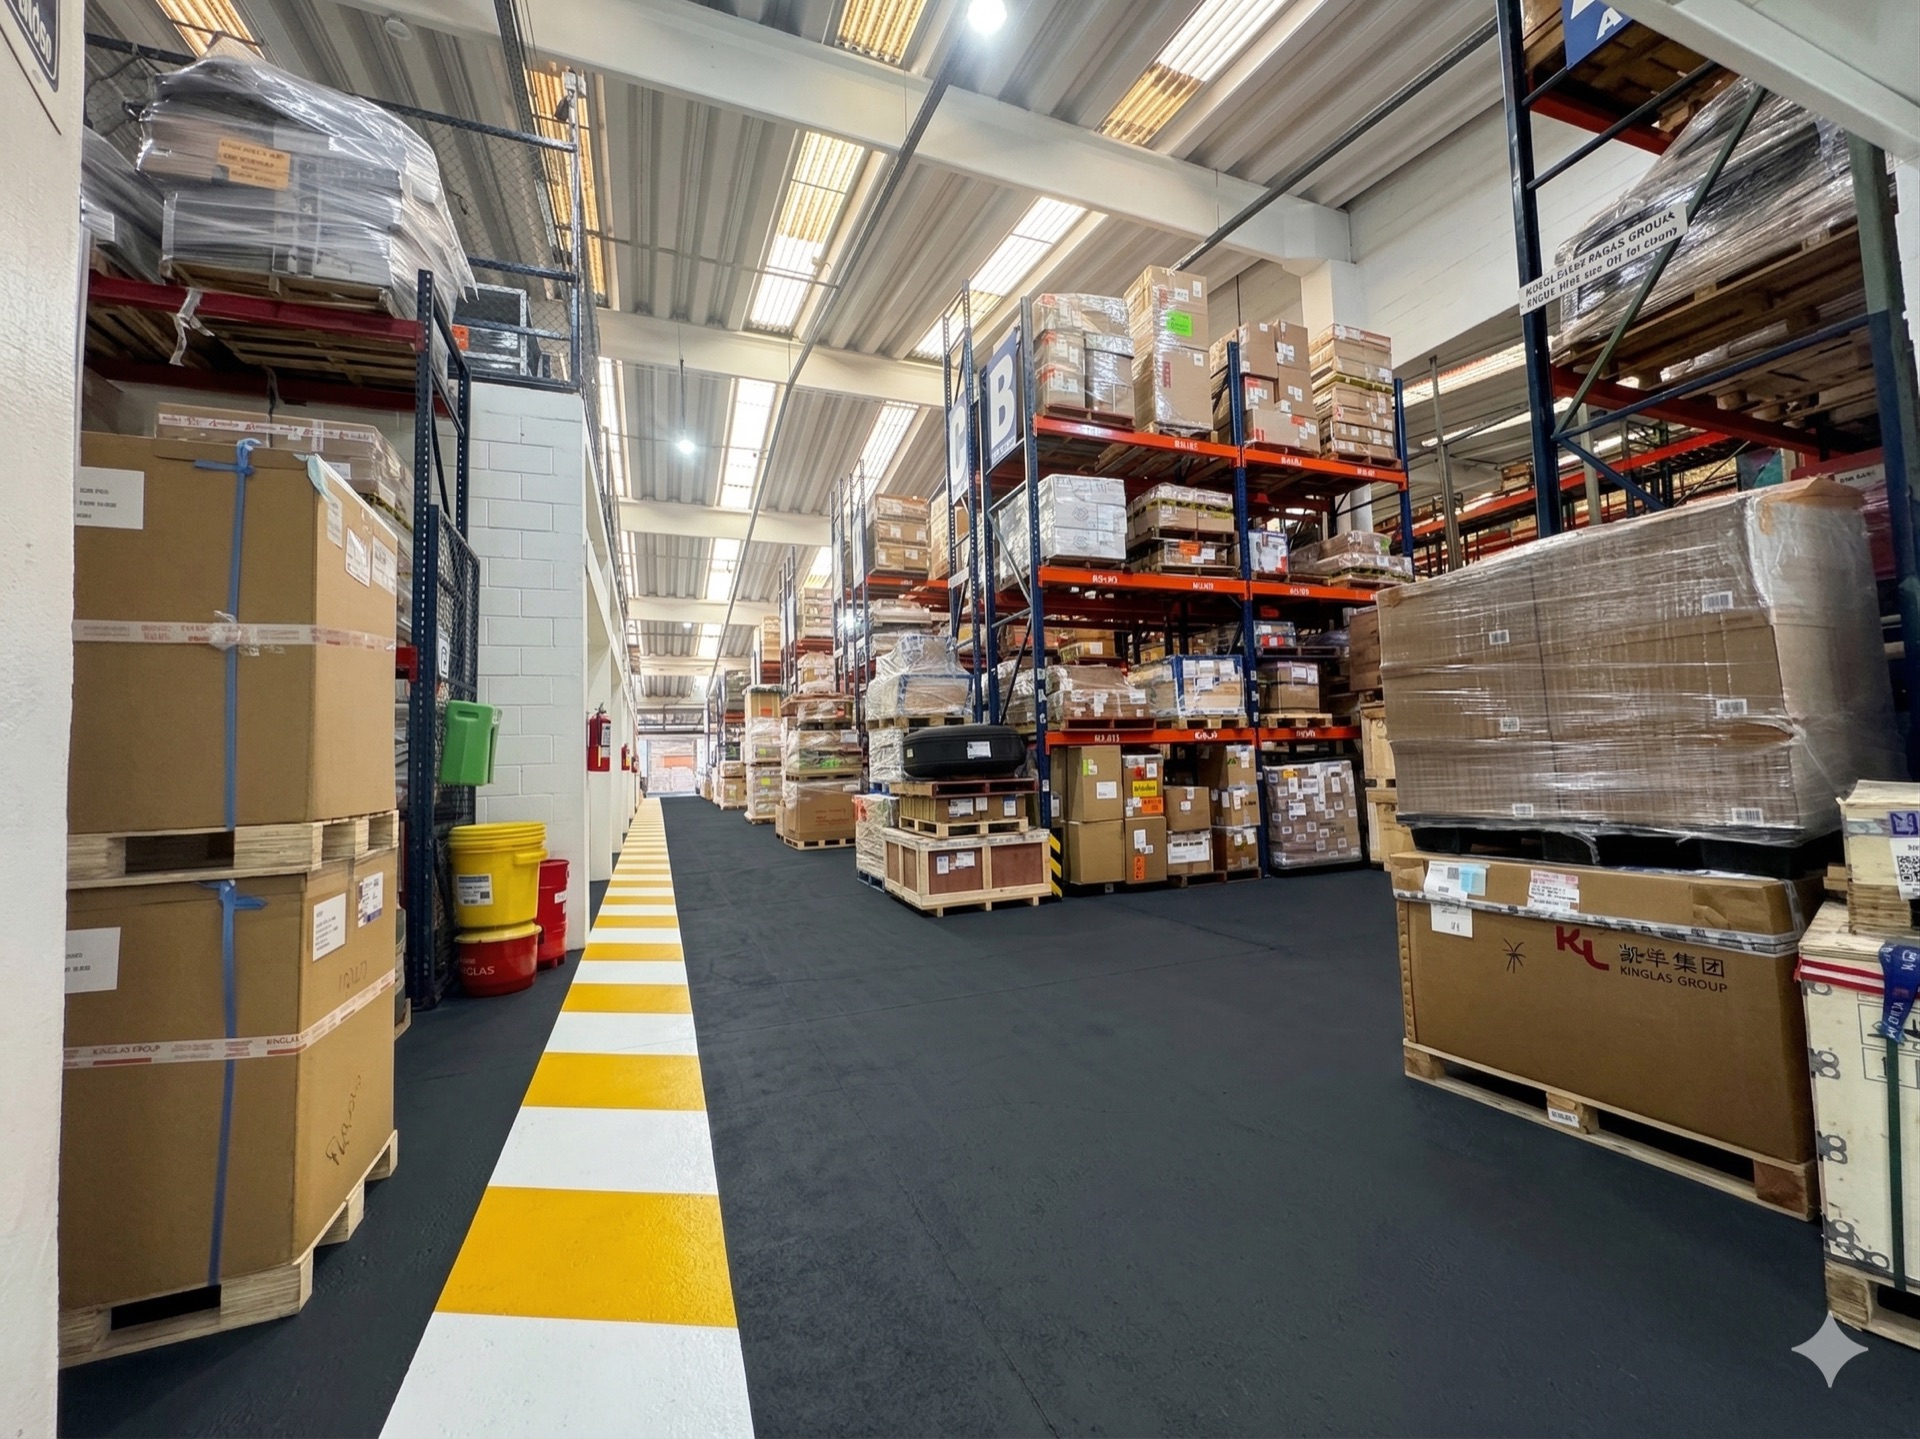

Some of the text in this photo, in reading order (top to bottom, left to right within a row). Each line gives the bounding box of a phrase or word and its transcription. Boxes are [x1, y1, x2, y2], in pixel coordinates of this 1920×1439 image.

[989, 354, 1015, 450] B
[950, 405, 967, 486] C
[1620, 966, 1728, 993] KINGLAS GROUP
